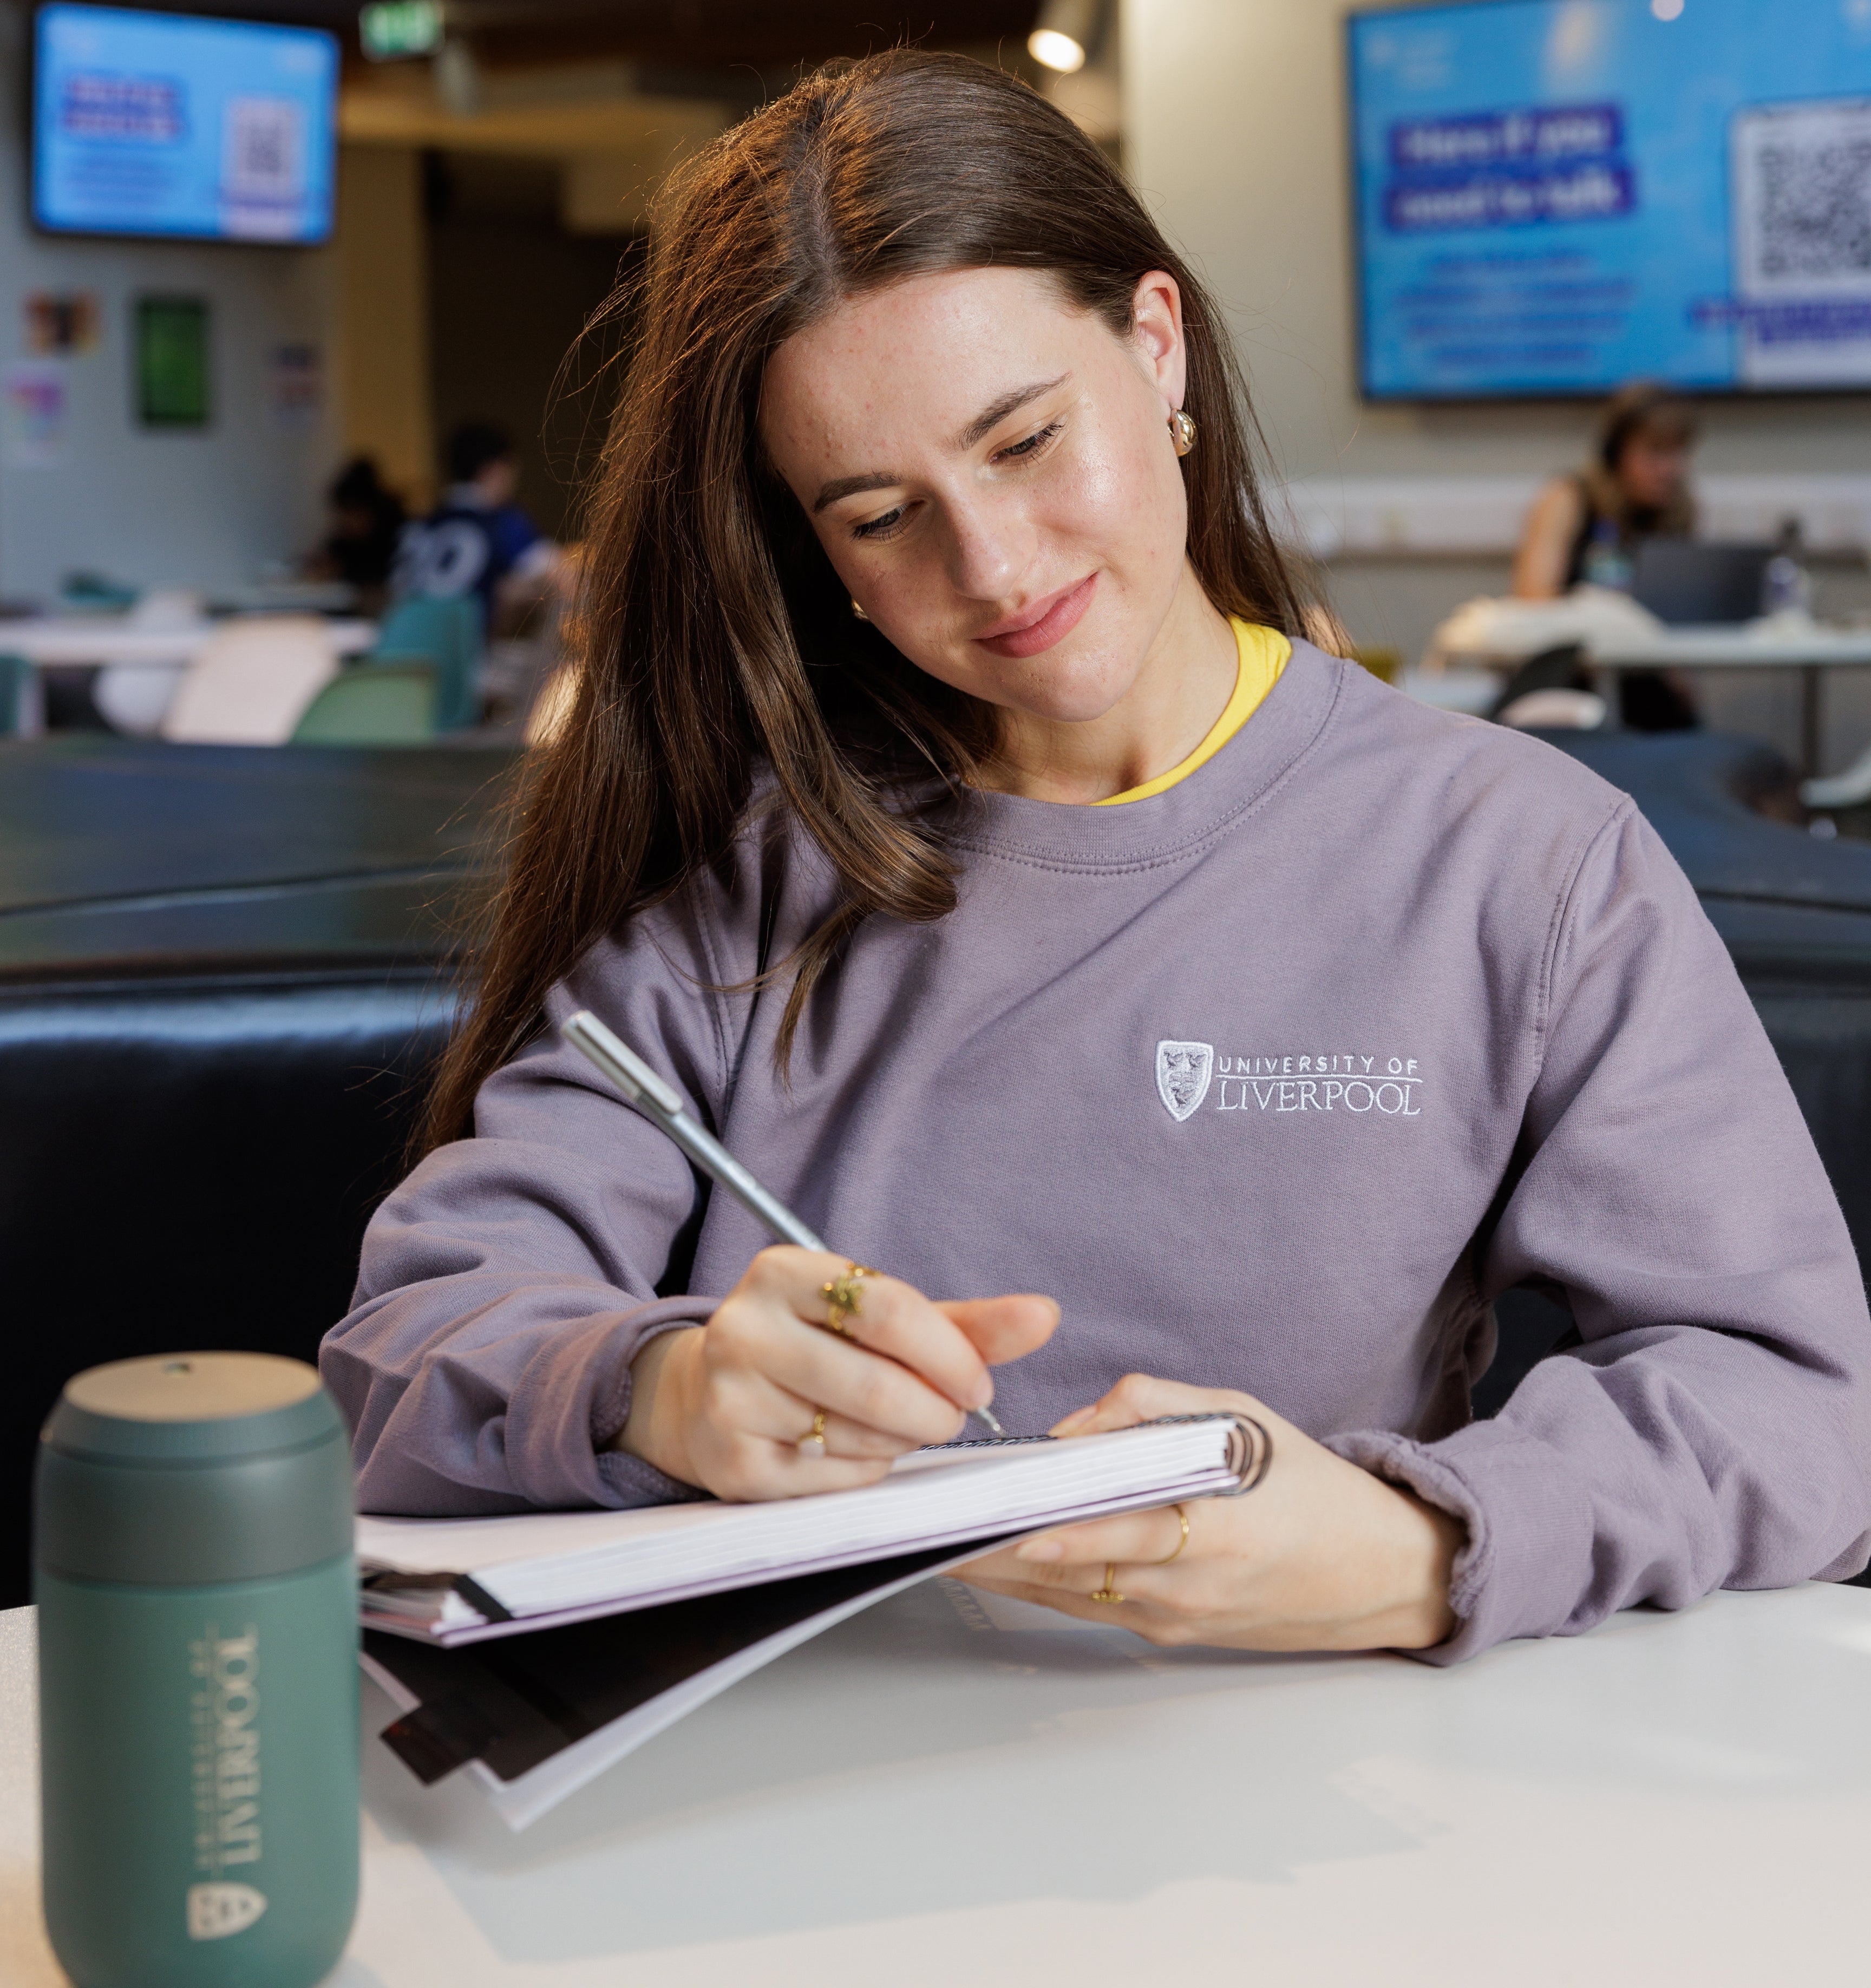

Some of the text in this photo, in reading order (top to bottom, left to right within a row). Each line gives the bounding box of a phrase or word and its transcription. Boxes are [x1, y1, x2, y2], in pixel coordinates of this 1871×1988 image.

[1219, 1055, 1418, 1075] UNIVERSITY OF
[1216, 1081, 1421, 1115] LIVERPOOL
[217, 1623, 261, 1866] LIVERPOOL
